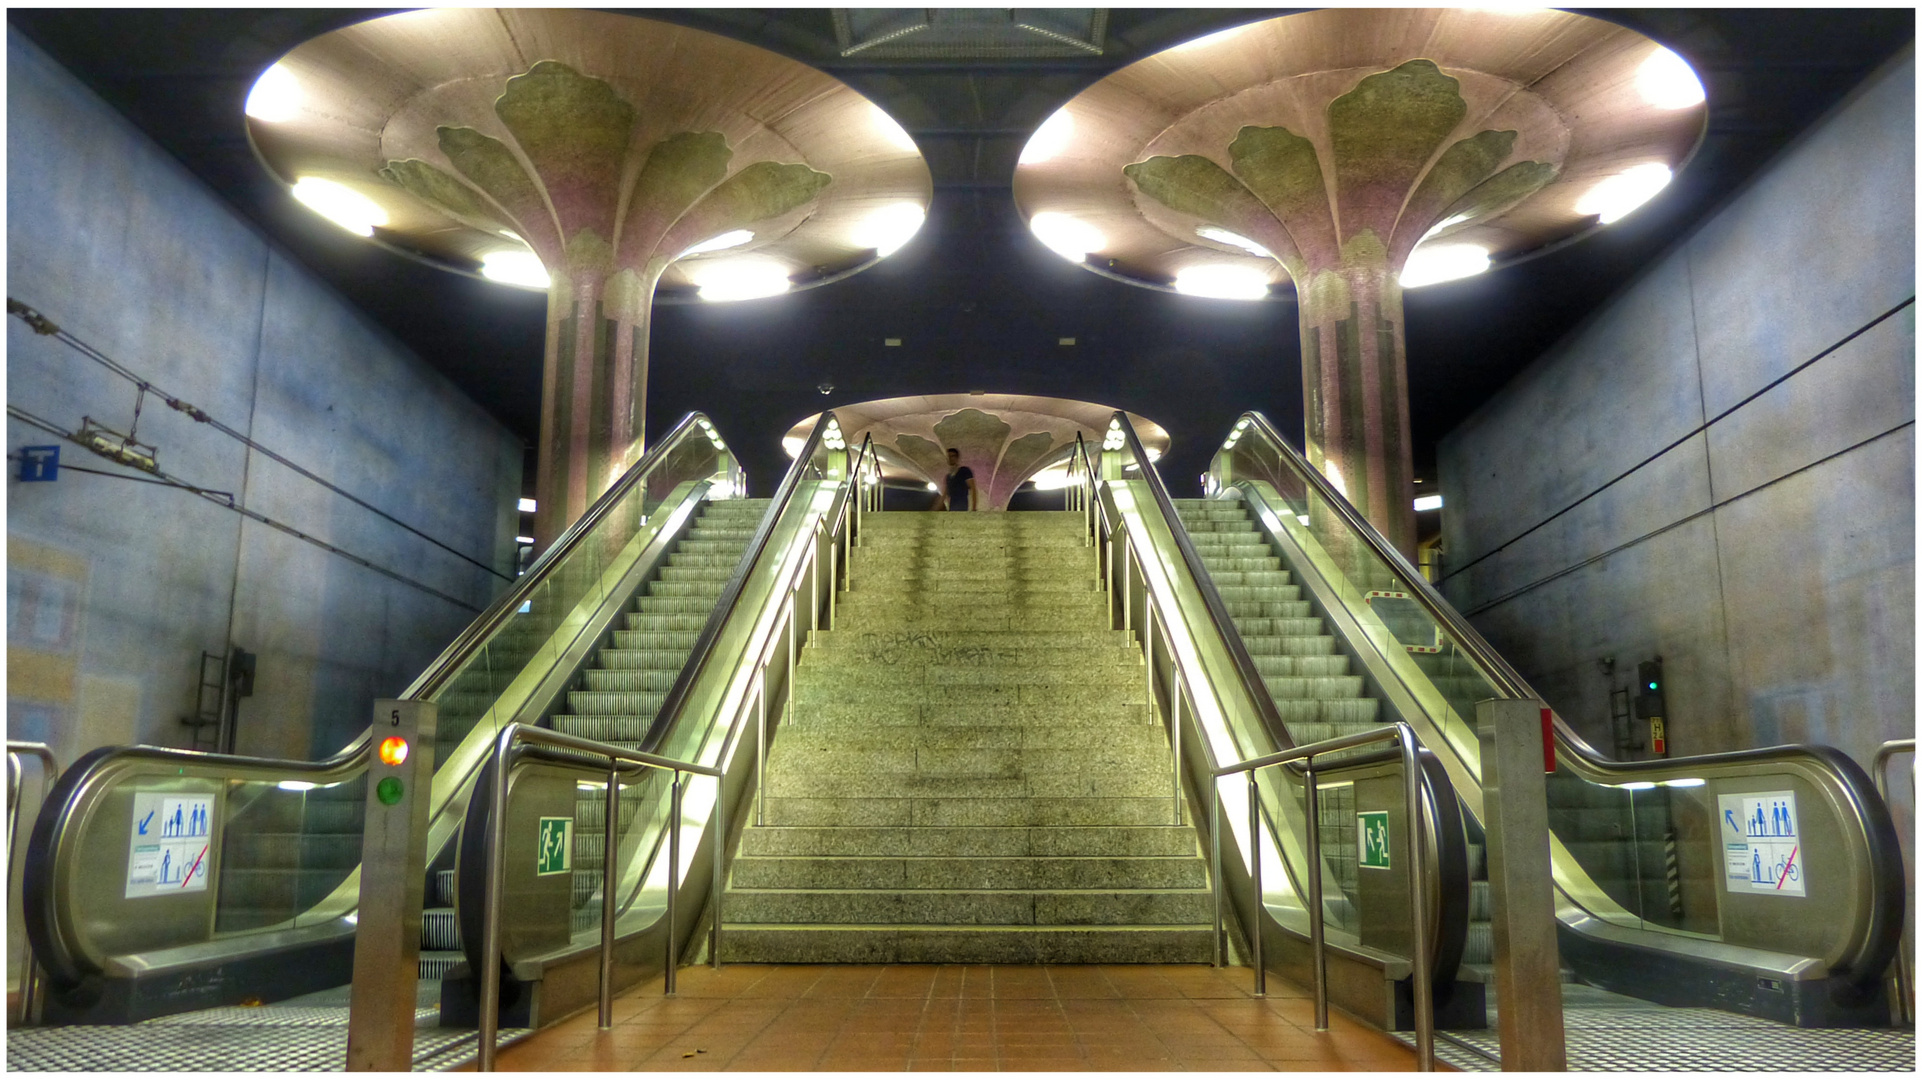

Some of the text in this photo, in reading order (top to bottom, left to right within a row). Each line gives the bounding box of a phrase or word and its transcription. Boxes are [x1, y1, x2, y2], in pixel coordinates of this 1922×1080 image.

[28, 450, 55, 478] T
[391, 709, 400, 727] 5
[1653, 723, 1661, 731] H
